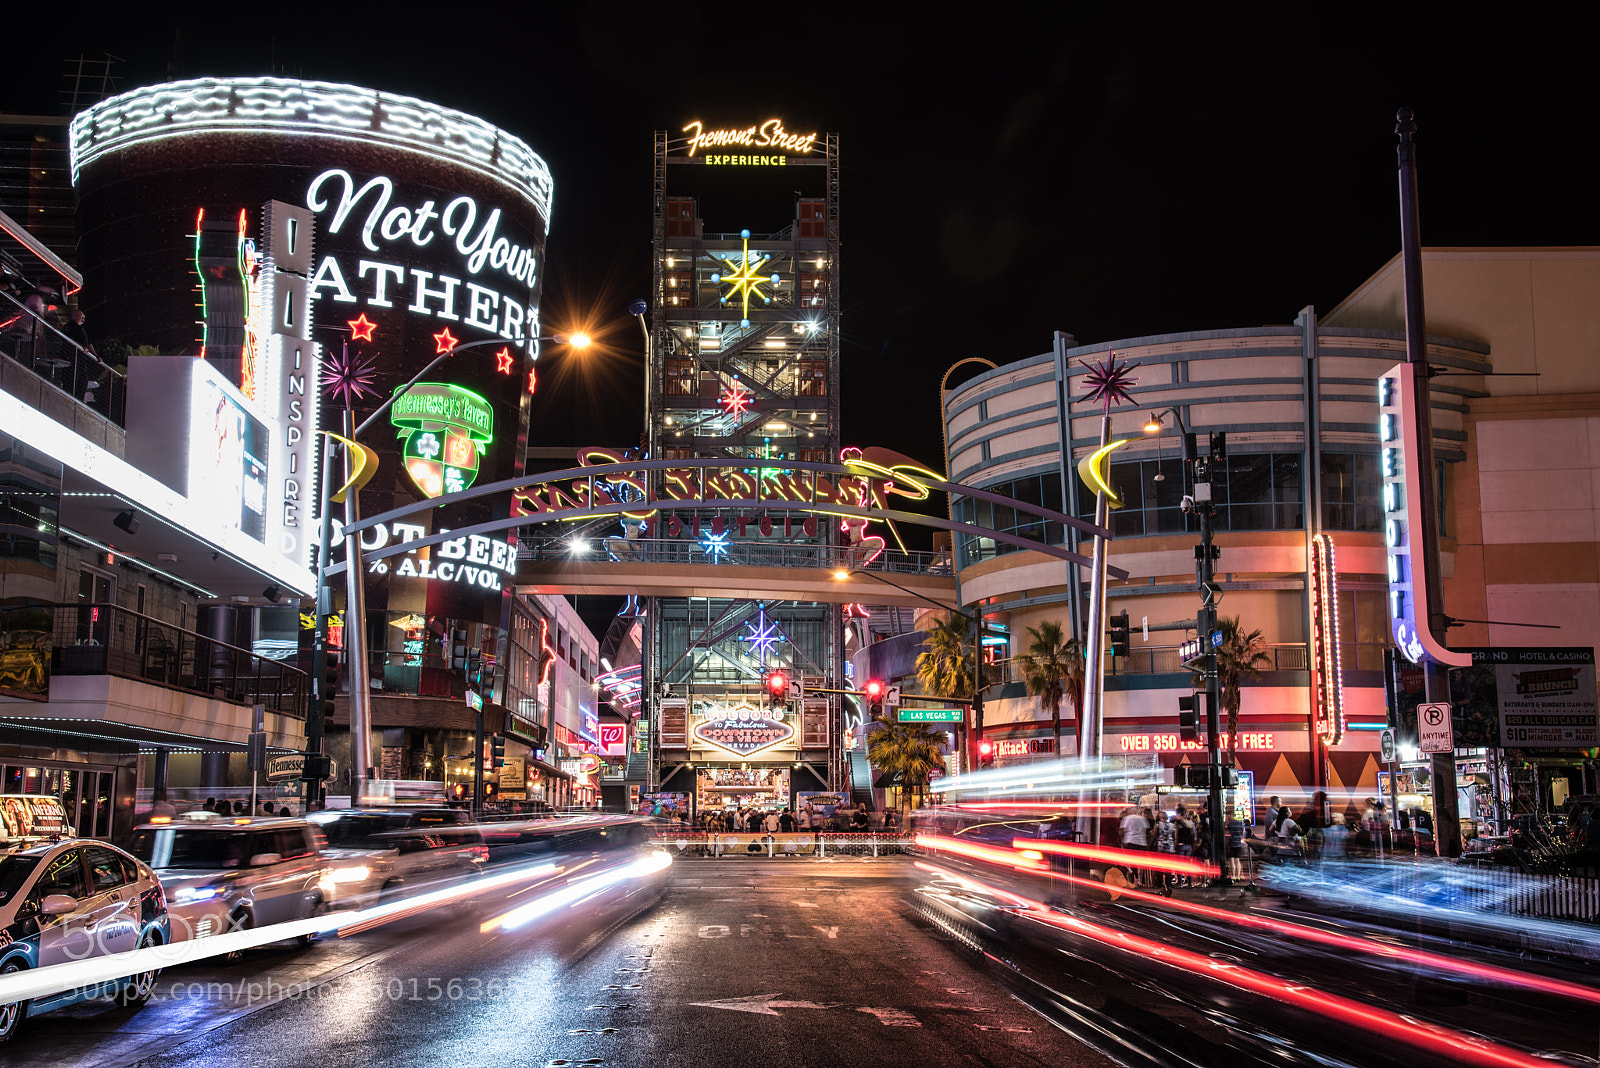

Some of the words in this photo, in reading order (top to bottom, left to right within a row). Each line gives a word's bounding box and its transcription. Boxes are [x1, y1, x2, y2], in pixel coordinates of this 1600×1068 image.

[682, 121, 757, 157] Fremont
[756, 118, 817, 153] Street
[705, 155, 787, 166] EXPERIENCE
[306, 168, 439, 252] Not
[442, 196, 536, 288] Your
[462, 397, 489, 430] Tavern
[1379, 377, 1402, 619] FREMONT
[314, 517, 426, 554] OOT
[437, 528, 519, 576] BEER
[396, 558, 501, 591] ALC/VOL
[1472, 651, 1508, 660] GRAND
[1519, 652, 1548, 660] HOTEL
[1528, 680, 1577, 692] BRUNCH
[706, 710, 782, 720] WELCOME
[910, 712, 923, 720] LAS
[925, 712, 947, 720] VEGAS
[1524, 716, 1541, 724] ALL
[1542, 716, 1558, 725] YOU
[1560, 717, 1577, 725] CAN
[724, 720, 769, 730] Fabulous
[713, 735, 734, 743] LAS
[737, 735, 776, 743] VEGAS
[1422, 731, 1449, 740] ANYTIME
[1506, 728, 1527, 741] $10
[999, 740, 1029, 756] Attack
[1121, 735, 1150, 750] OVER
[1153, 735, 1178, 750] 350
[1242, 734, 1274, 749] FREE
[270, 757, 304, 773] Hennesse
[30, 804, 63, 815] INFERNO
